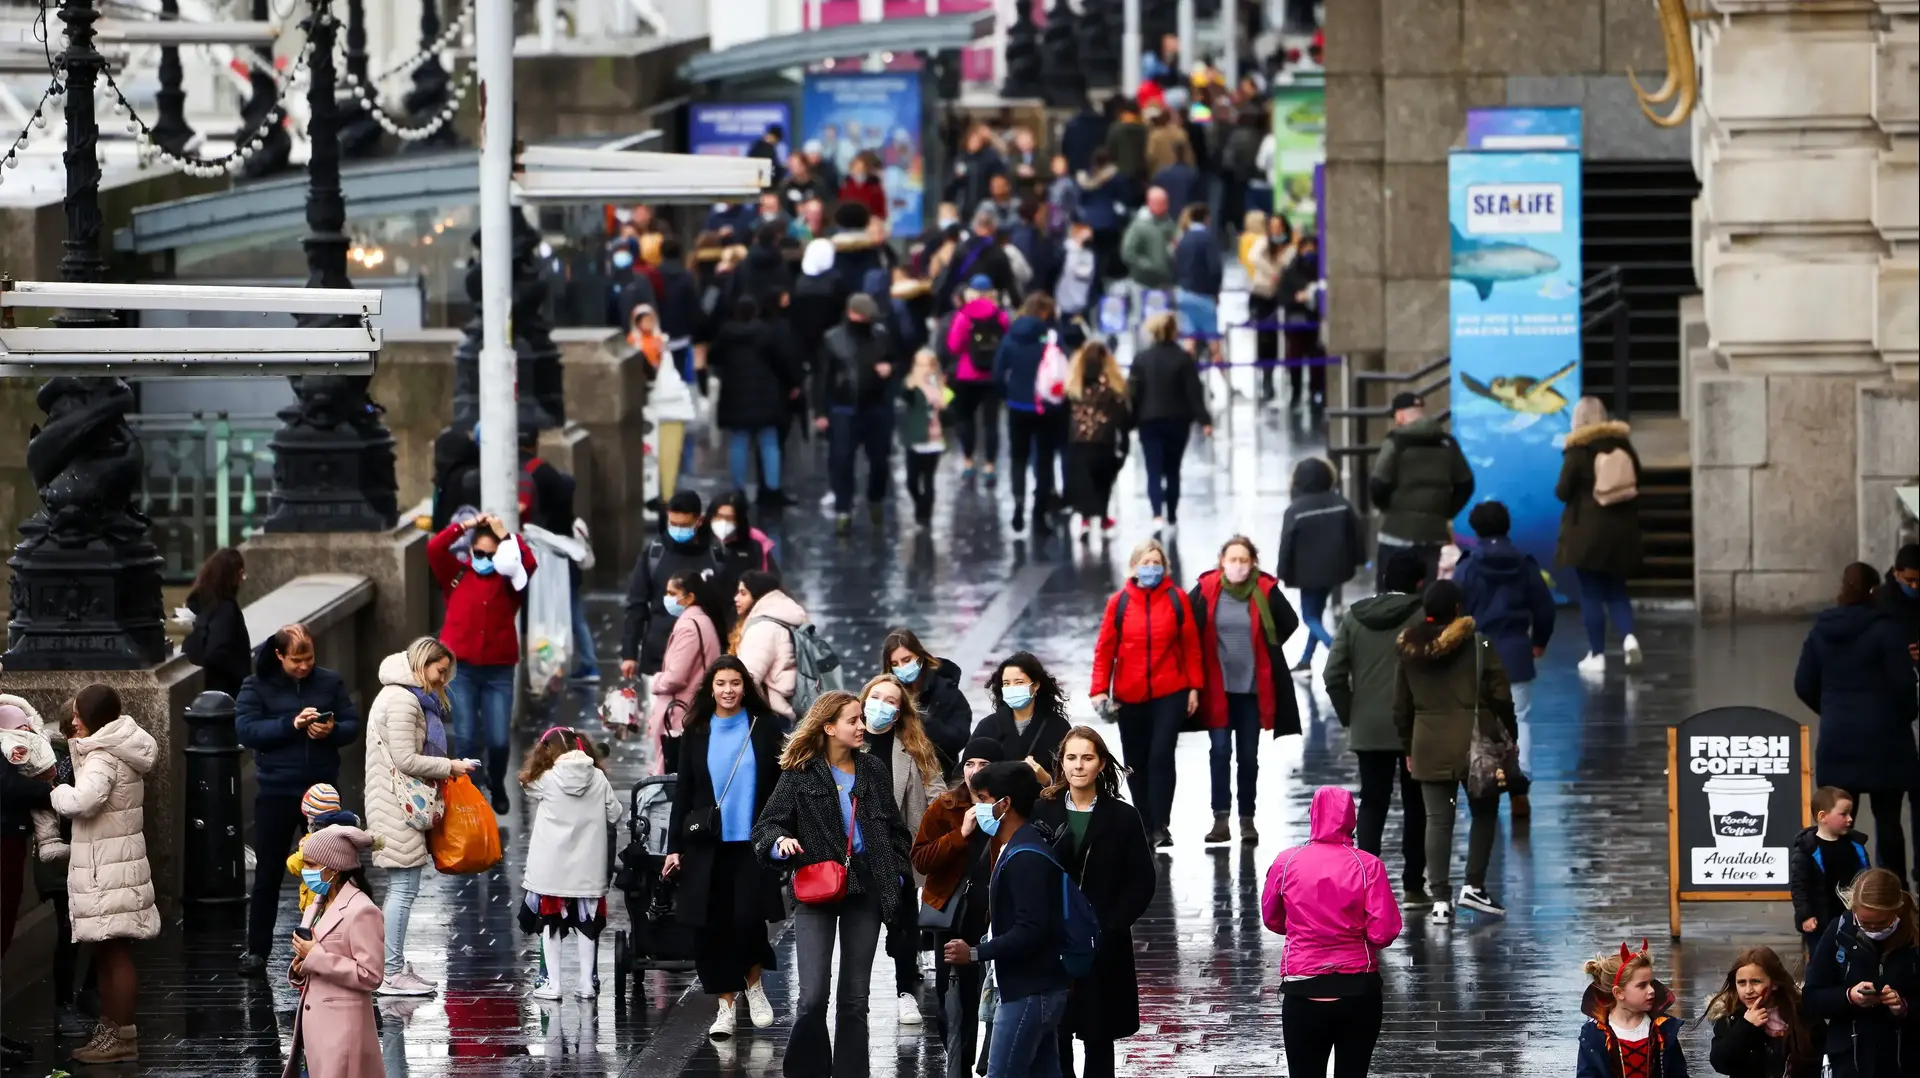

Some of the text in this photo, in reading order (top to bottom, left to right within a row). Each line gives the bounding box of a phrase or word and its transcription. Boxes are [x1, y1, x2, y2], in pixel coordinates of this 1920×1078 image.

[1473, 194, 1510, 215] SEA
[1690, 736, 1790, 757] FRESH
[1690, 757, 1790, 774] COFFEE
[1720, 815, 1758, 826] Rocky
[1720, 825, 1758, 836] Coffee
[1704, 851, 1776, 864] Available
[1721, 867, 1759, 879] Here
